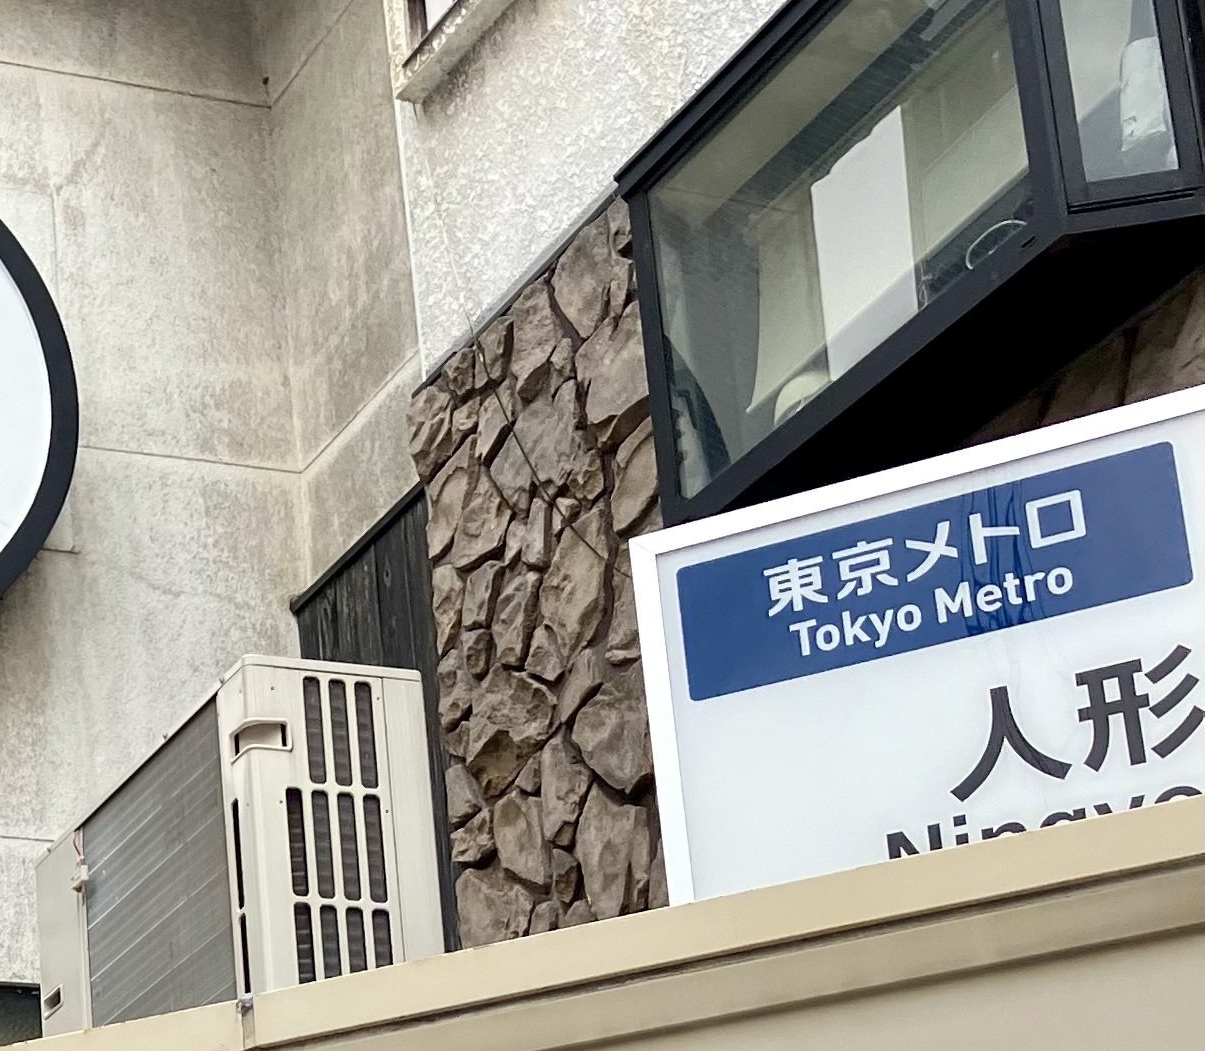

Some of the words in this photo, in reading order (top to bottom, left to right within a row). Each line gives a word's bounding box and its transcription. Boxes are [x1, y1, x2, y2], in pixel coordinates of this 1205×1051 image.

[763, 489, 1087, 617] 東京メトロ
[789, 603, 922, 658] Tokyo
[935, 565, 1074, 624] Metro
[951, 644, 1205, 801] 人形
